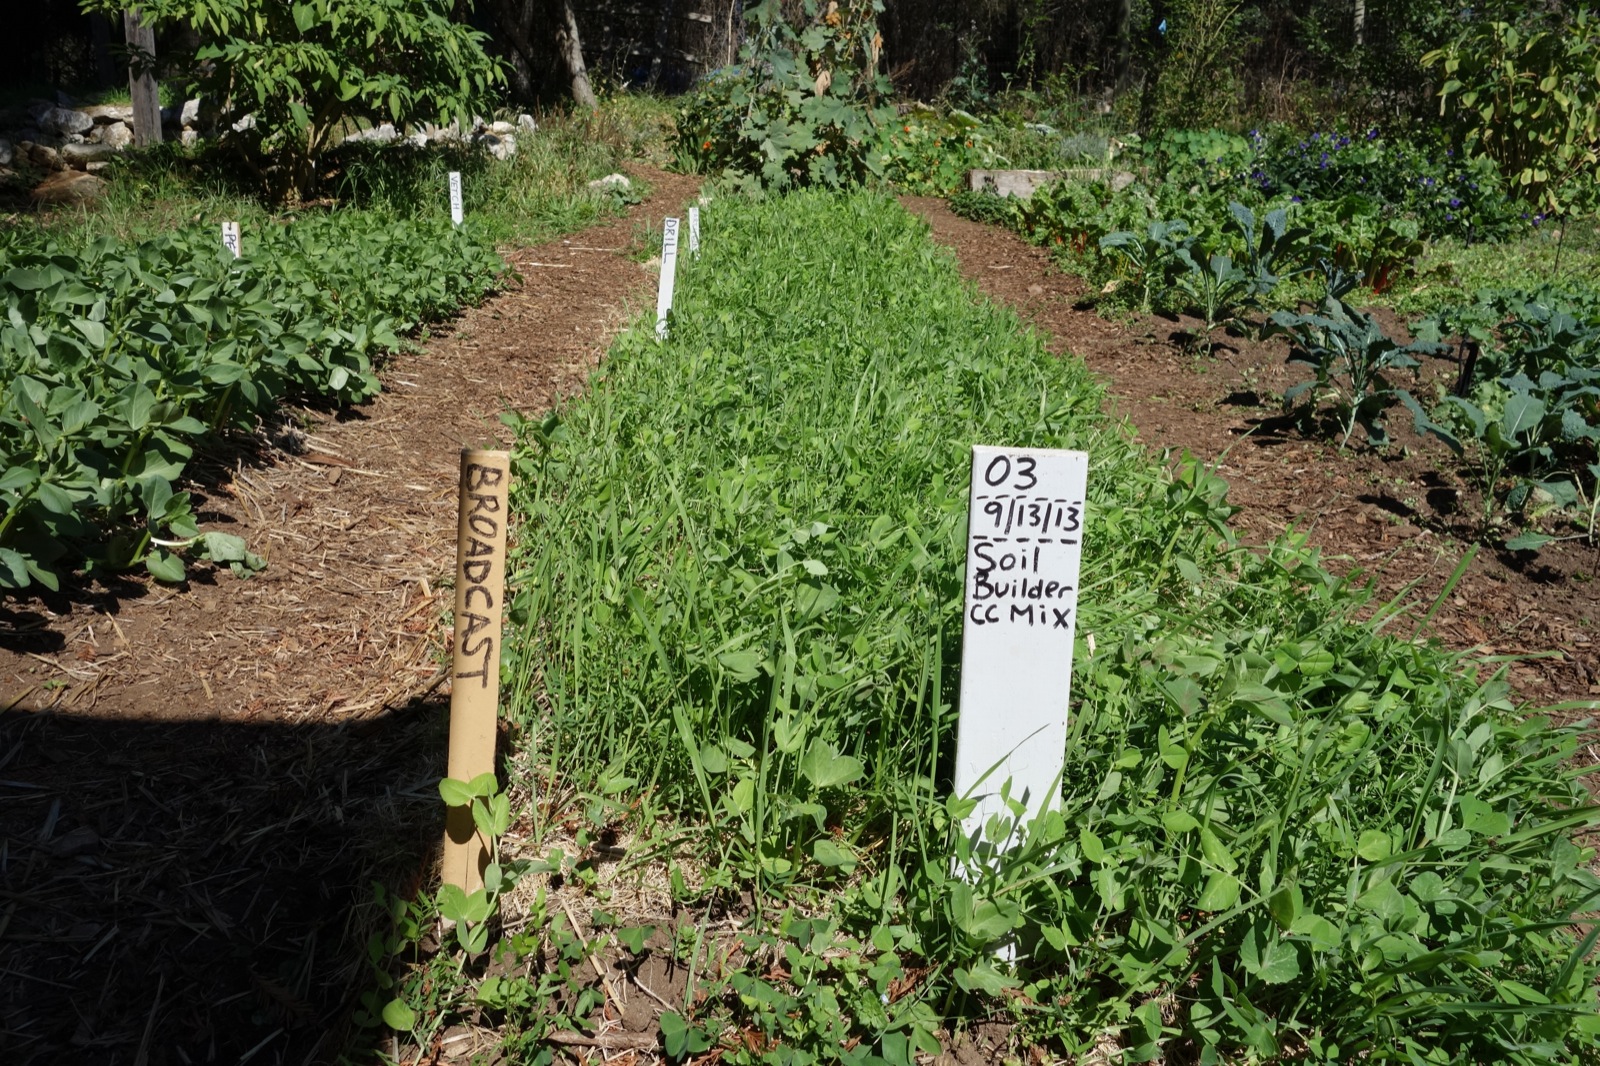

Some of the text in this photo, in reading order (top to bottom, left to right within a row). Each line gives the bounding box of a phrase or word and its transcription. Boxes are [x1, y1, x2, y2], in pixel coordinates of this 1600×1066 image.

[450, 175, 460, 210] VETCH
[664, 219, 677, 264] DRILL
[984, 455, 1038, 490] 03
[983, 498, 1080, 535] 9/13/13
[456, 463, 503, 689] BROADCAST
[973, 542, 1040, 575] Soil
[972, 570, 1073, 600] Builder
[970, 603, 1000, 625] CC
